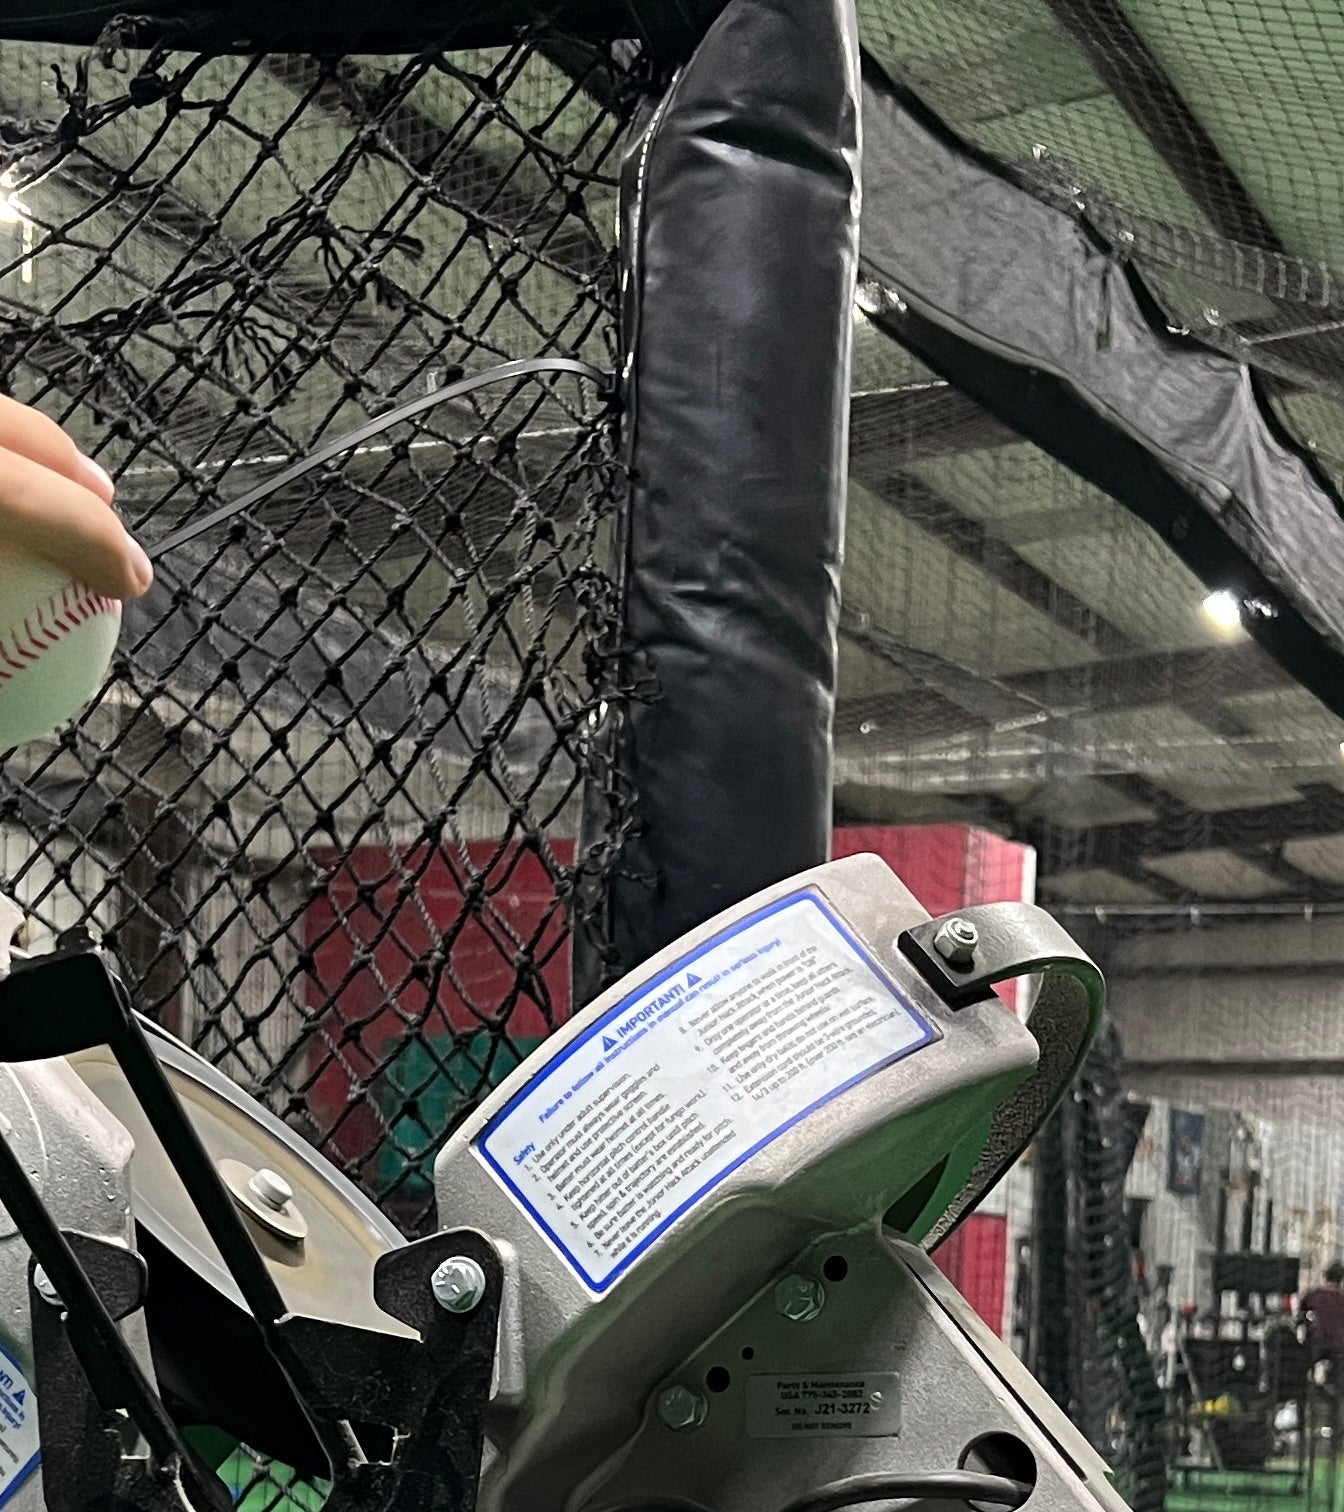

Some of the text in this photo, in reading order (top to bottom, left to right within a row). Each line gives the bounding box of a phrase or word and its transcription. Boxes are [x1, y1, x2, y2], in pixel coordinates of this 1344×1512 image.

[563, 1089, 573, 1099] to
[603, 1026, 648, 1063] instructions
[512, 1141, 537, 1165] Safety
[532, 1148, 546, 1163] Use
[544, 1136, 560, 1152] only
[815, 1403, 870, 1414] J21-3272
